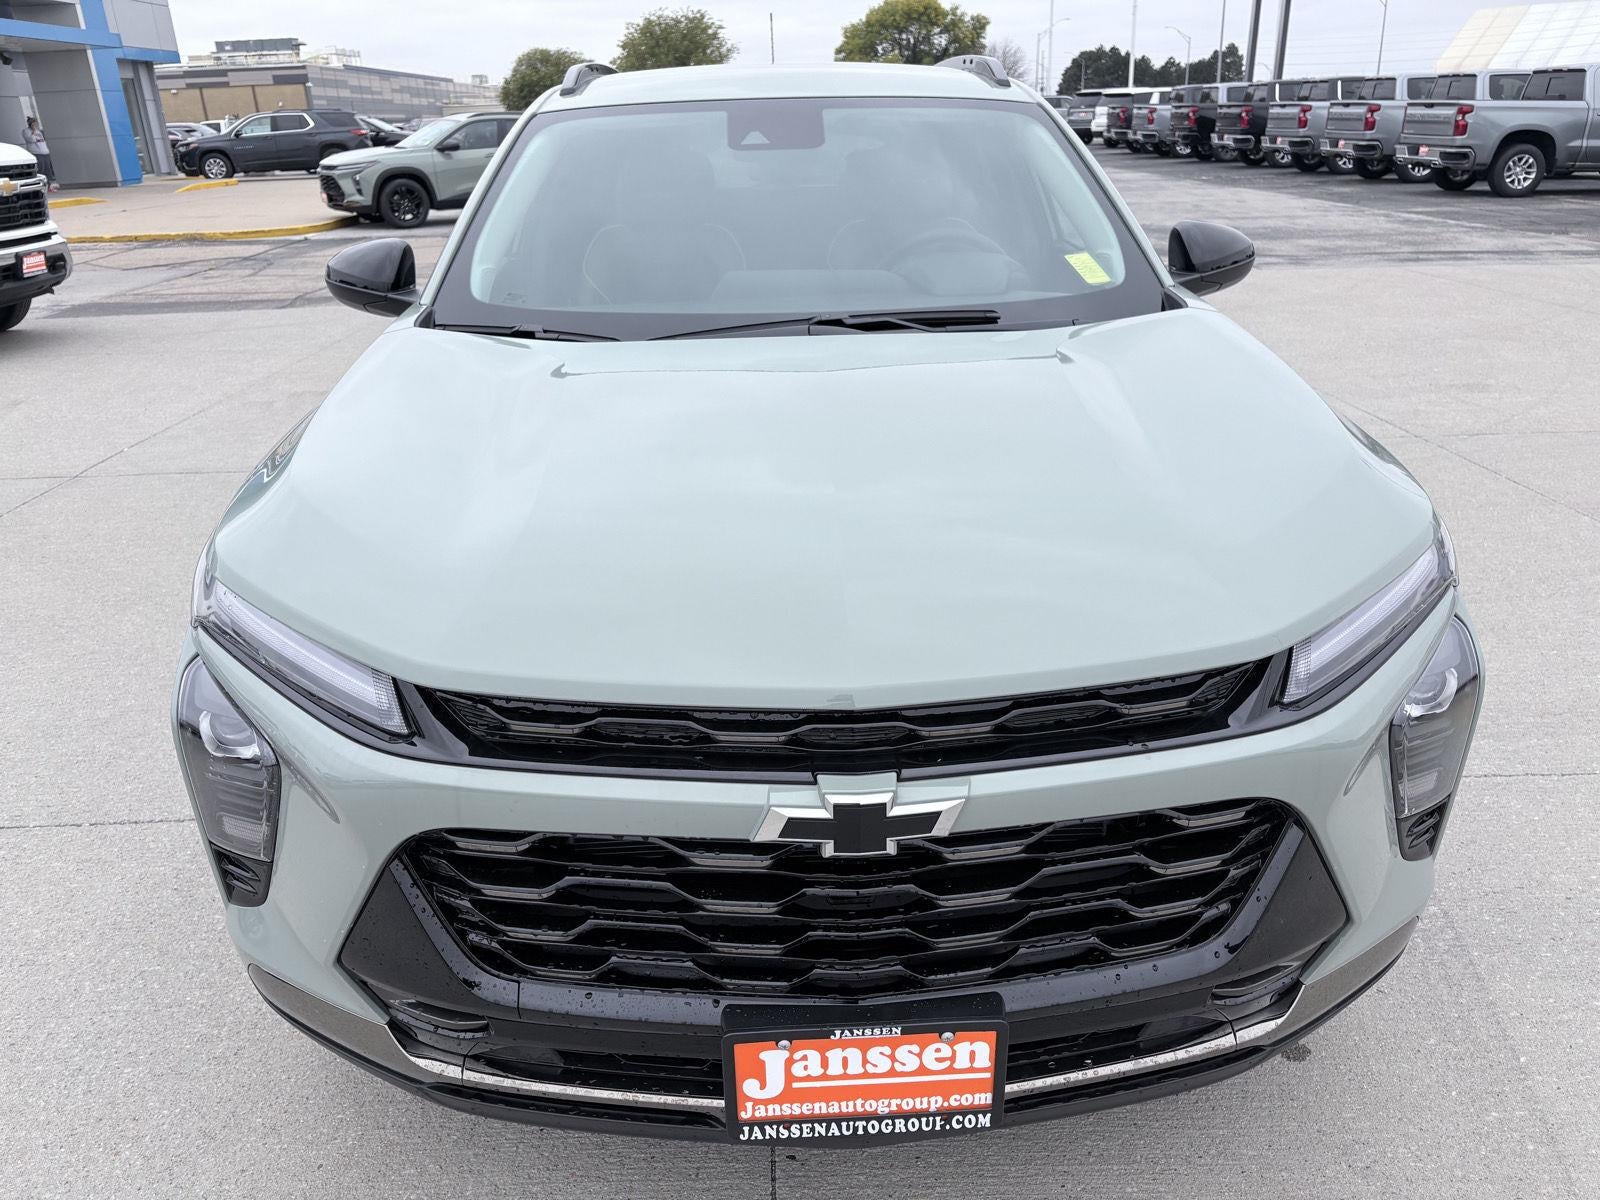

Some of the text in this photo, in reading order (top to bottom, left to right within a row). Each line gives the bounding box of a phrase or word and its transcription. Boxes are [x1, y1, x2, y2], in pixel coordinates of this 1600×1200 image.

[831, 1027, 901, 1039] JANSSEN
[742, 1041, 992, 1099] Janssen
[740, 1090, 992, 1119] Janssenautogroup.com
[739, 1113, 992, 1141] JANSSENAUTOGROUP.COM
